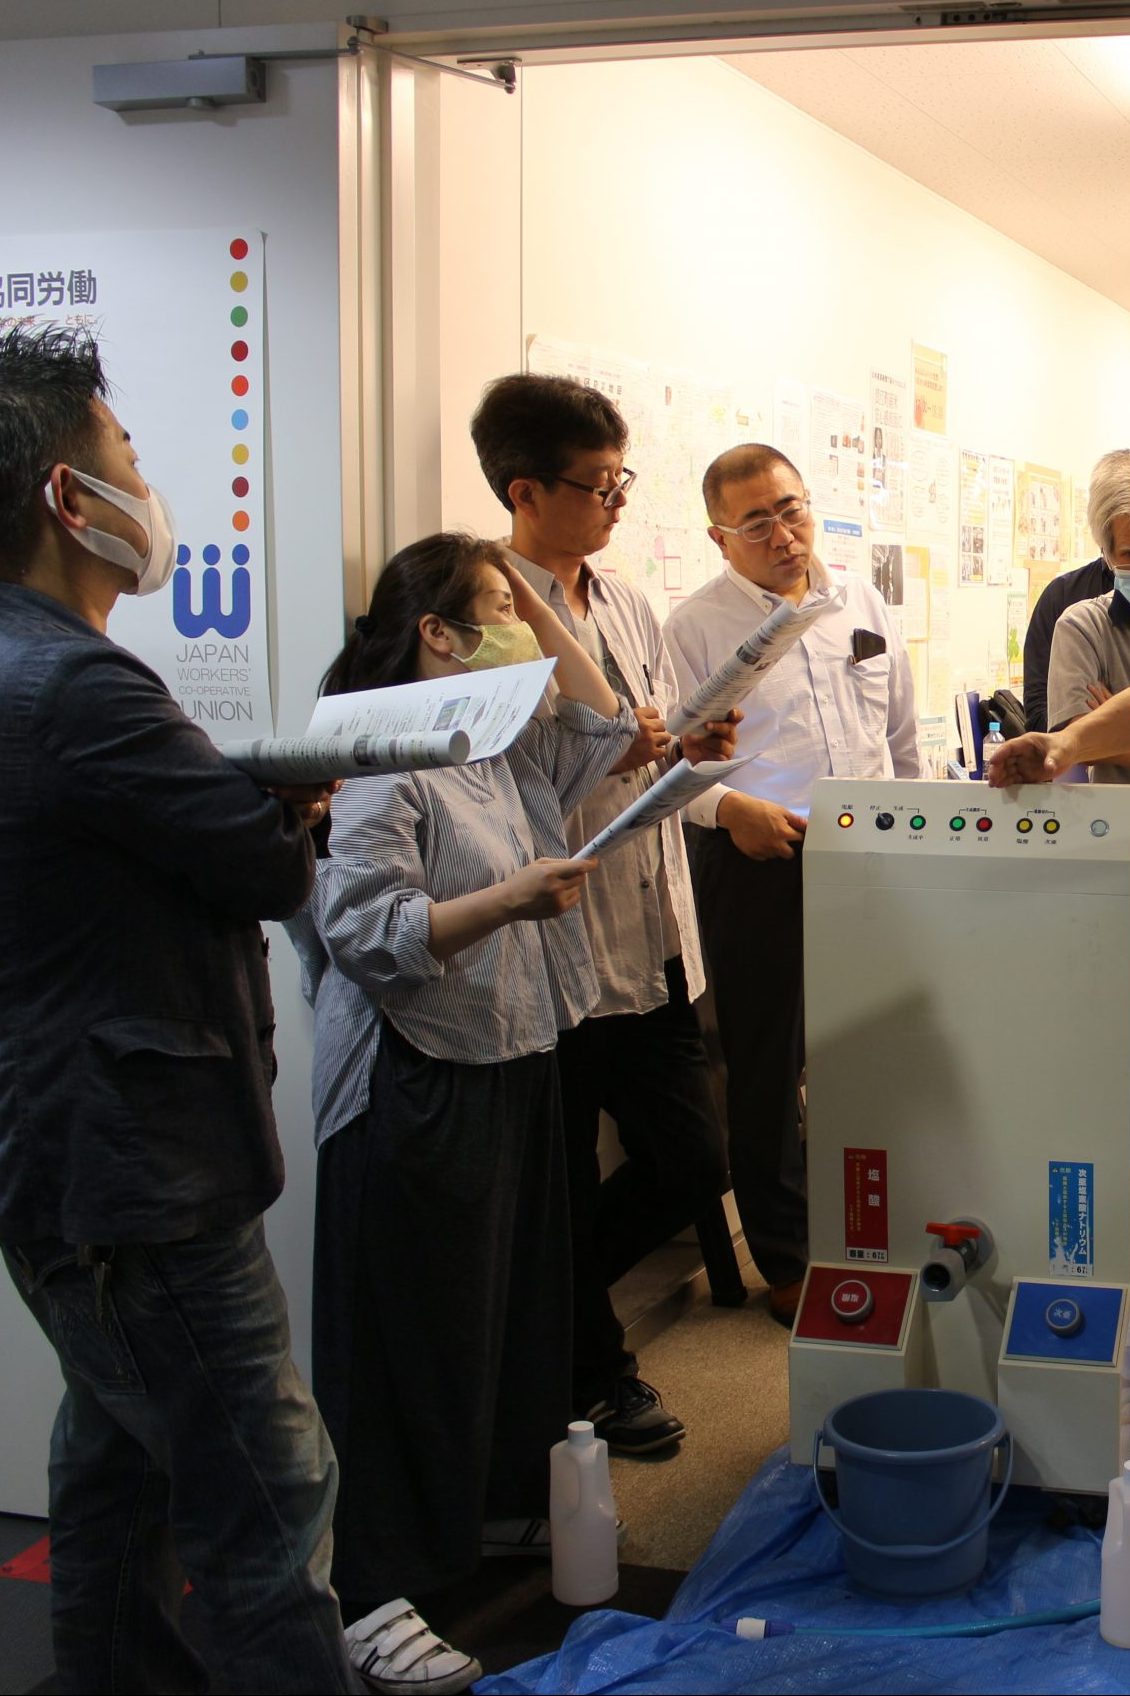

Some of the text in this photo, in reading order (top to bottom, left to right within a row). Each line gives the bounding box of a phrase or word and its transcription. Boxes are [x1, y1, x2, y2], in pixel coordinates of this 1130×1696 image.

[176, 643, 249, 664] JAPAN
[178, 685, 251, 696] CO-OPERATIVE
[179, 699, 254, 721] UNION
